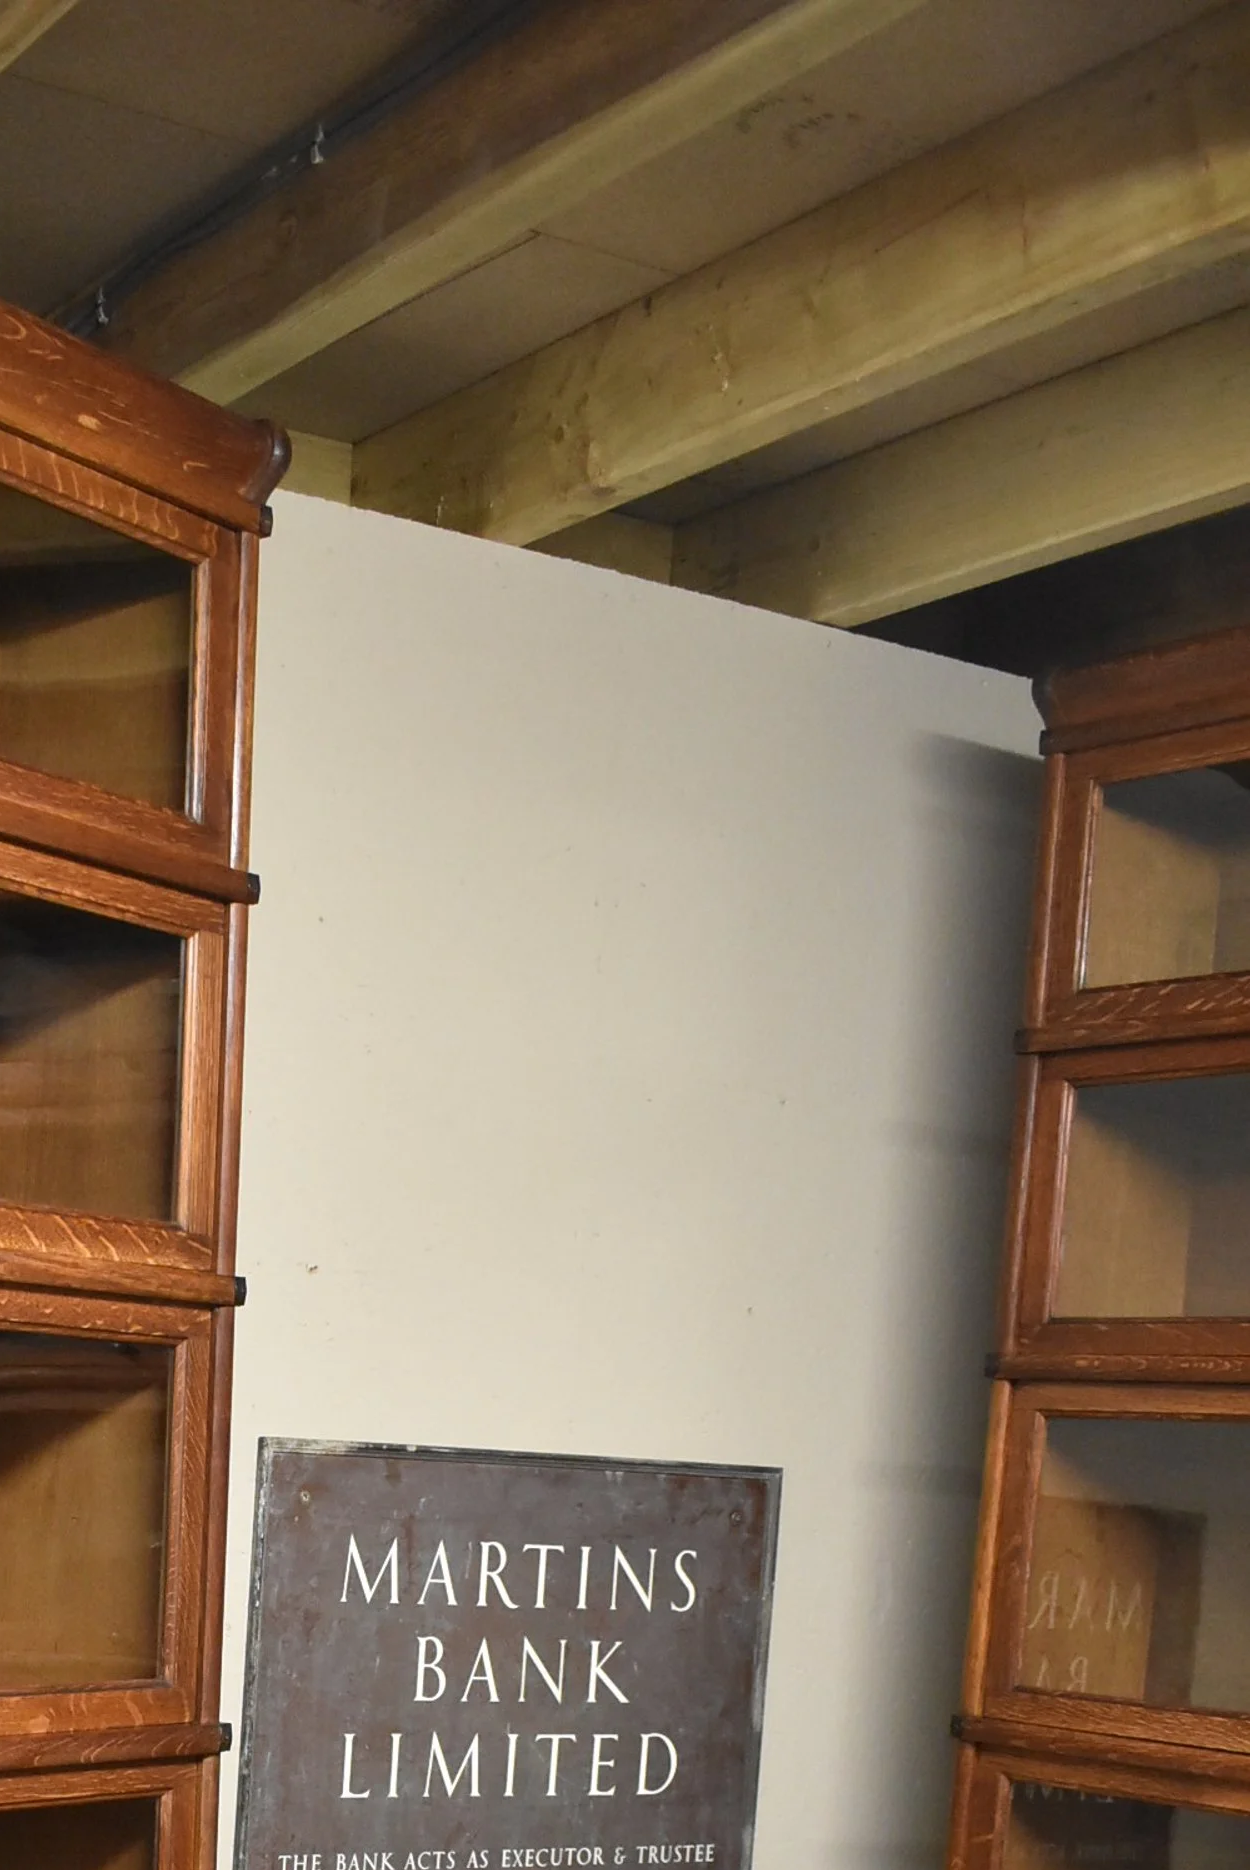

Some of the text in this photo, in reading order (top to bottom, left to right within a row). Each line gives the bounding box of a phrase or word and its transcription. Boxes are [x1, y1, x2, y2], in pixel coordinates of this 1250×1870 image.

[339, 1533, 698, 1612] MARTINS
[413, 1635, 630, 1704] BANK
[339, 1731, 678, 1799] LIMITED
[403, 1850, 456, 1870] ACTS
[466, 1849, 490, 1869] AS
[501, 1846, 605, 1868] EXECUTOR
[613, 1845, 626, 1865] &
[636, 1843, 716, 1864] TRUSTEE
